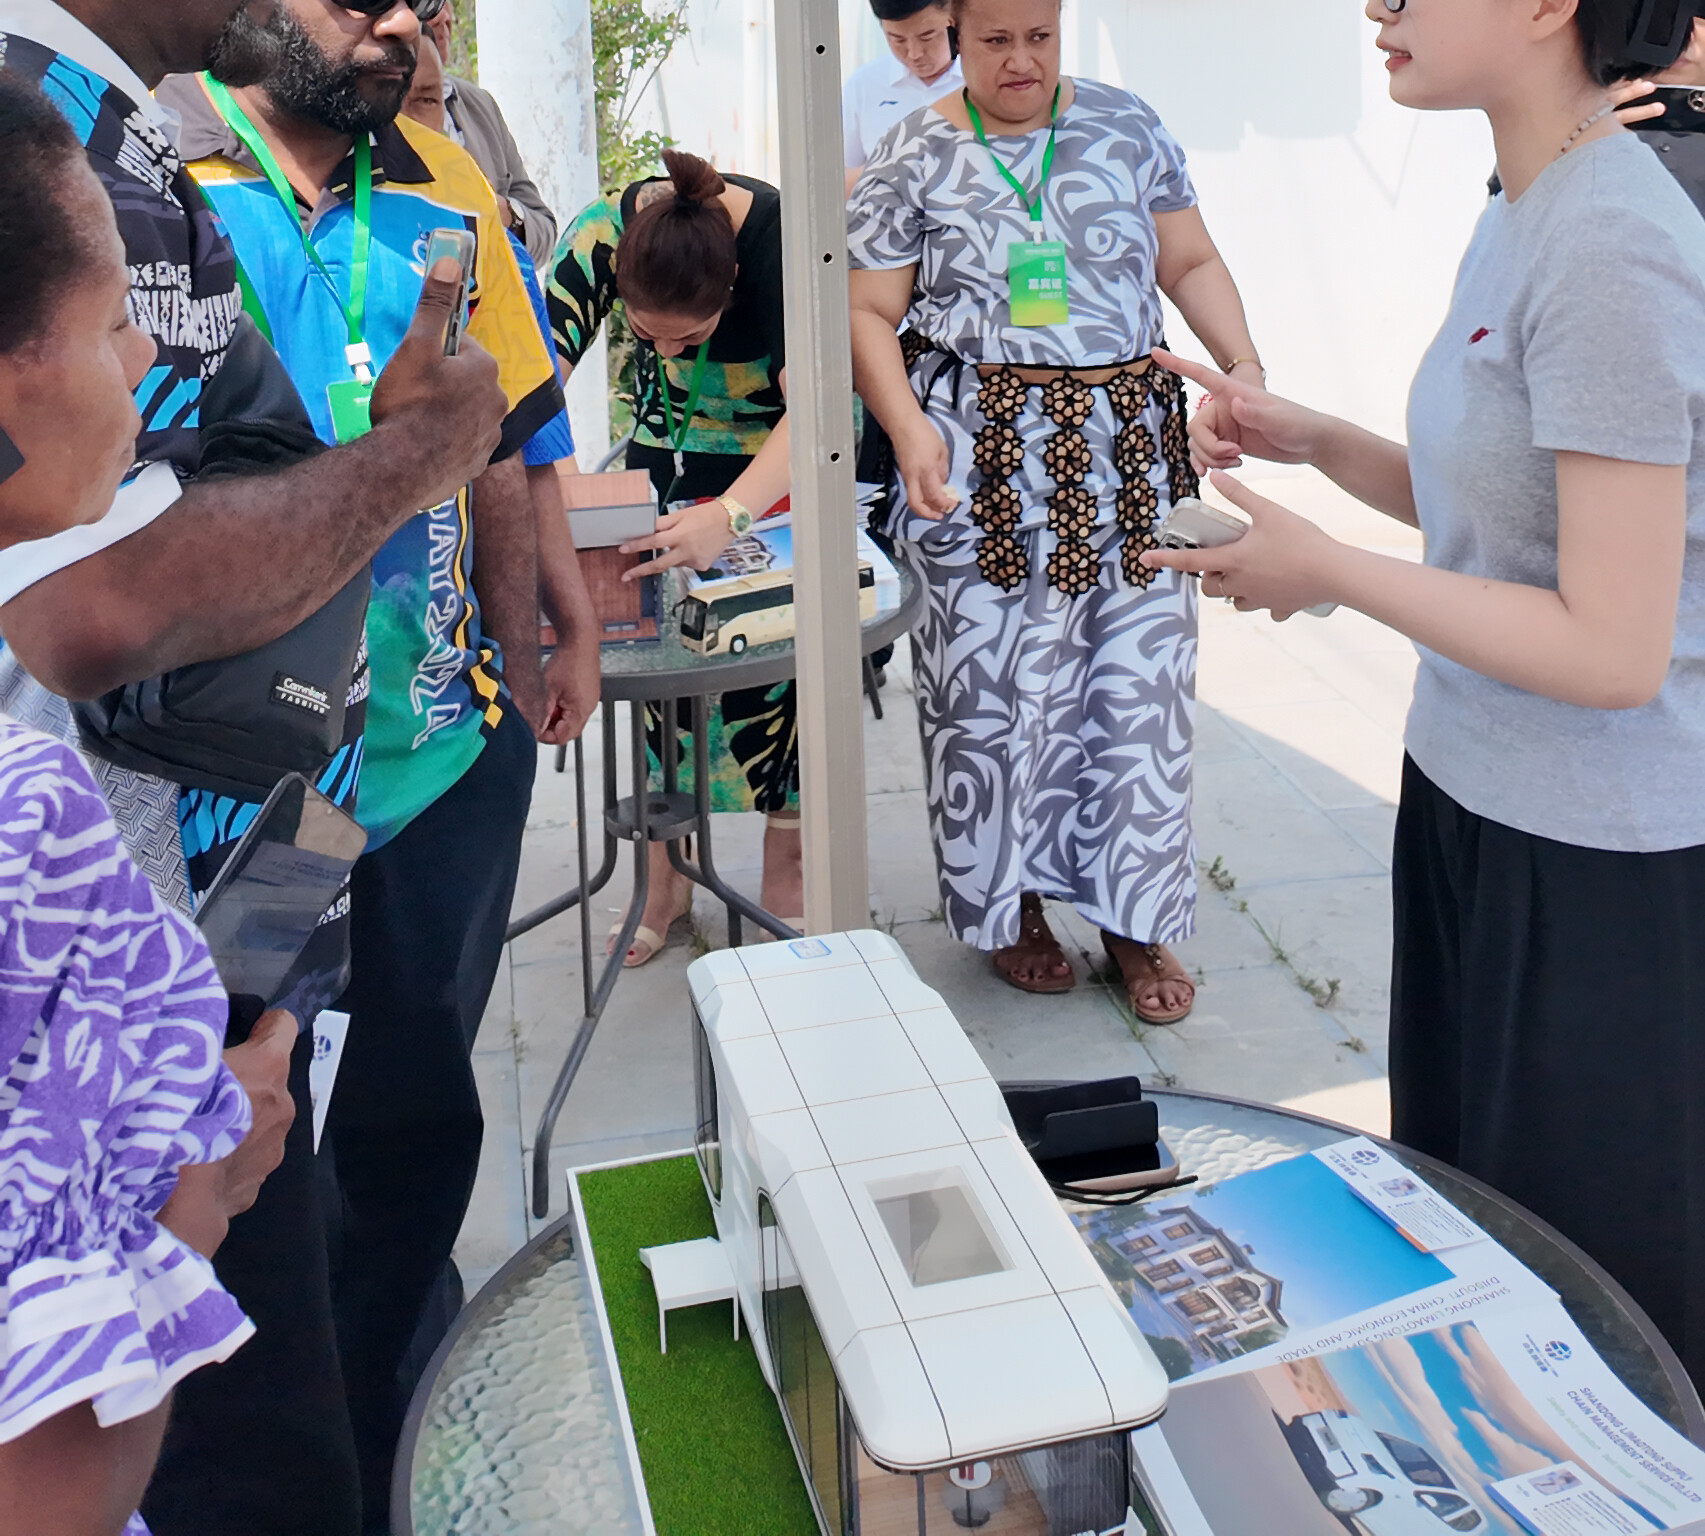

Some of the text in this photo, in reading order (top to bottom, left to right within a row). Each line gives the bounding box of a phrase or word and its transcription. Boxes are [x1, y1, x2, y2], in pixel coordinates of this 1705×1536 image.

[1444, 1285, 1511, 1315] SHANDONG
[1448, 1276, 1501, 1300] DJIBOUTI
[1343, 1309, 1408, 1340] ECONOMIC
[1274, 1343, 1315, 1363] TRADE
[1316, 1333, 1342, 1348] AND
[1566, 1390, 1594, 1415] CHAIN
[1589, 1415, 1644, 1460] MANAGEMENT
[1638, 1459, 1675, 1483] SERVICE
[1579, 1386, 1625, 1428] SHANDONG
[1660, 1461, 1695, 1482] SUPPLY
